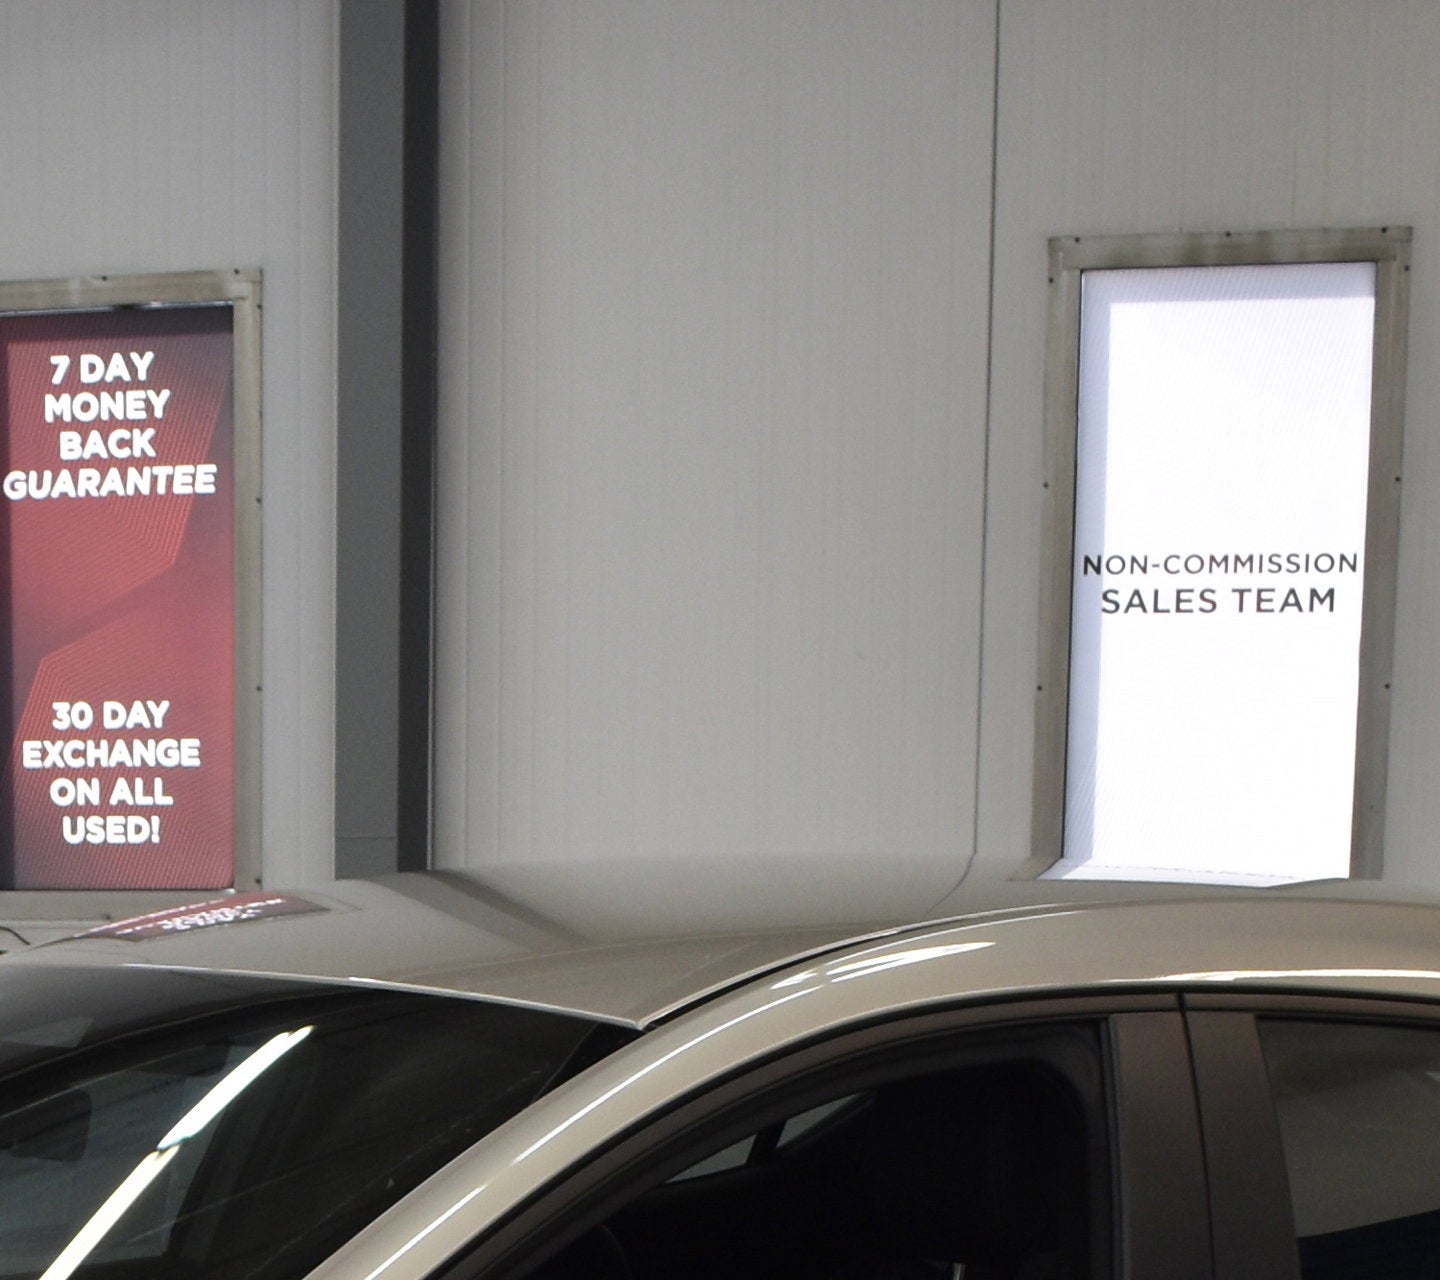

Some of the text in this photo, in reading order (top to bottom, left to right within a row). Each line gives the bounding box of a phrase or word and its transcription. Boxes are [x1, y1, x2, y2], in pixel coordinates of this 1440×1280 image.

[50, 352, 154, 384] 7 DAY
[45, 389, 170, 422] MONEY
[60, 428, 156, 460] BACK
[4, 464, 217, 500] GUARANTEE
[1083, 554, 1357, 576] NON-COMMISSION
[1102, 588, 1334, 613] SALES TEAM
[52, 701, 169, 730] 30 DAY
[23, 739, 200, 768] EXCHANGE
[50, 778, 173, 806] ON ALL
[63, 816, 159, 844] USED!
